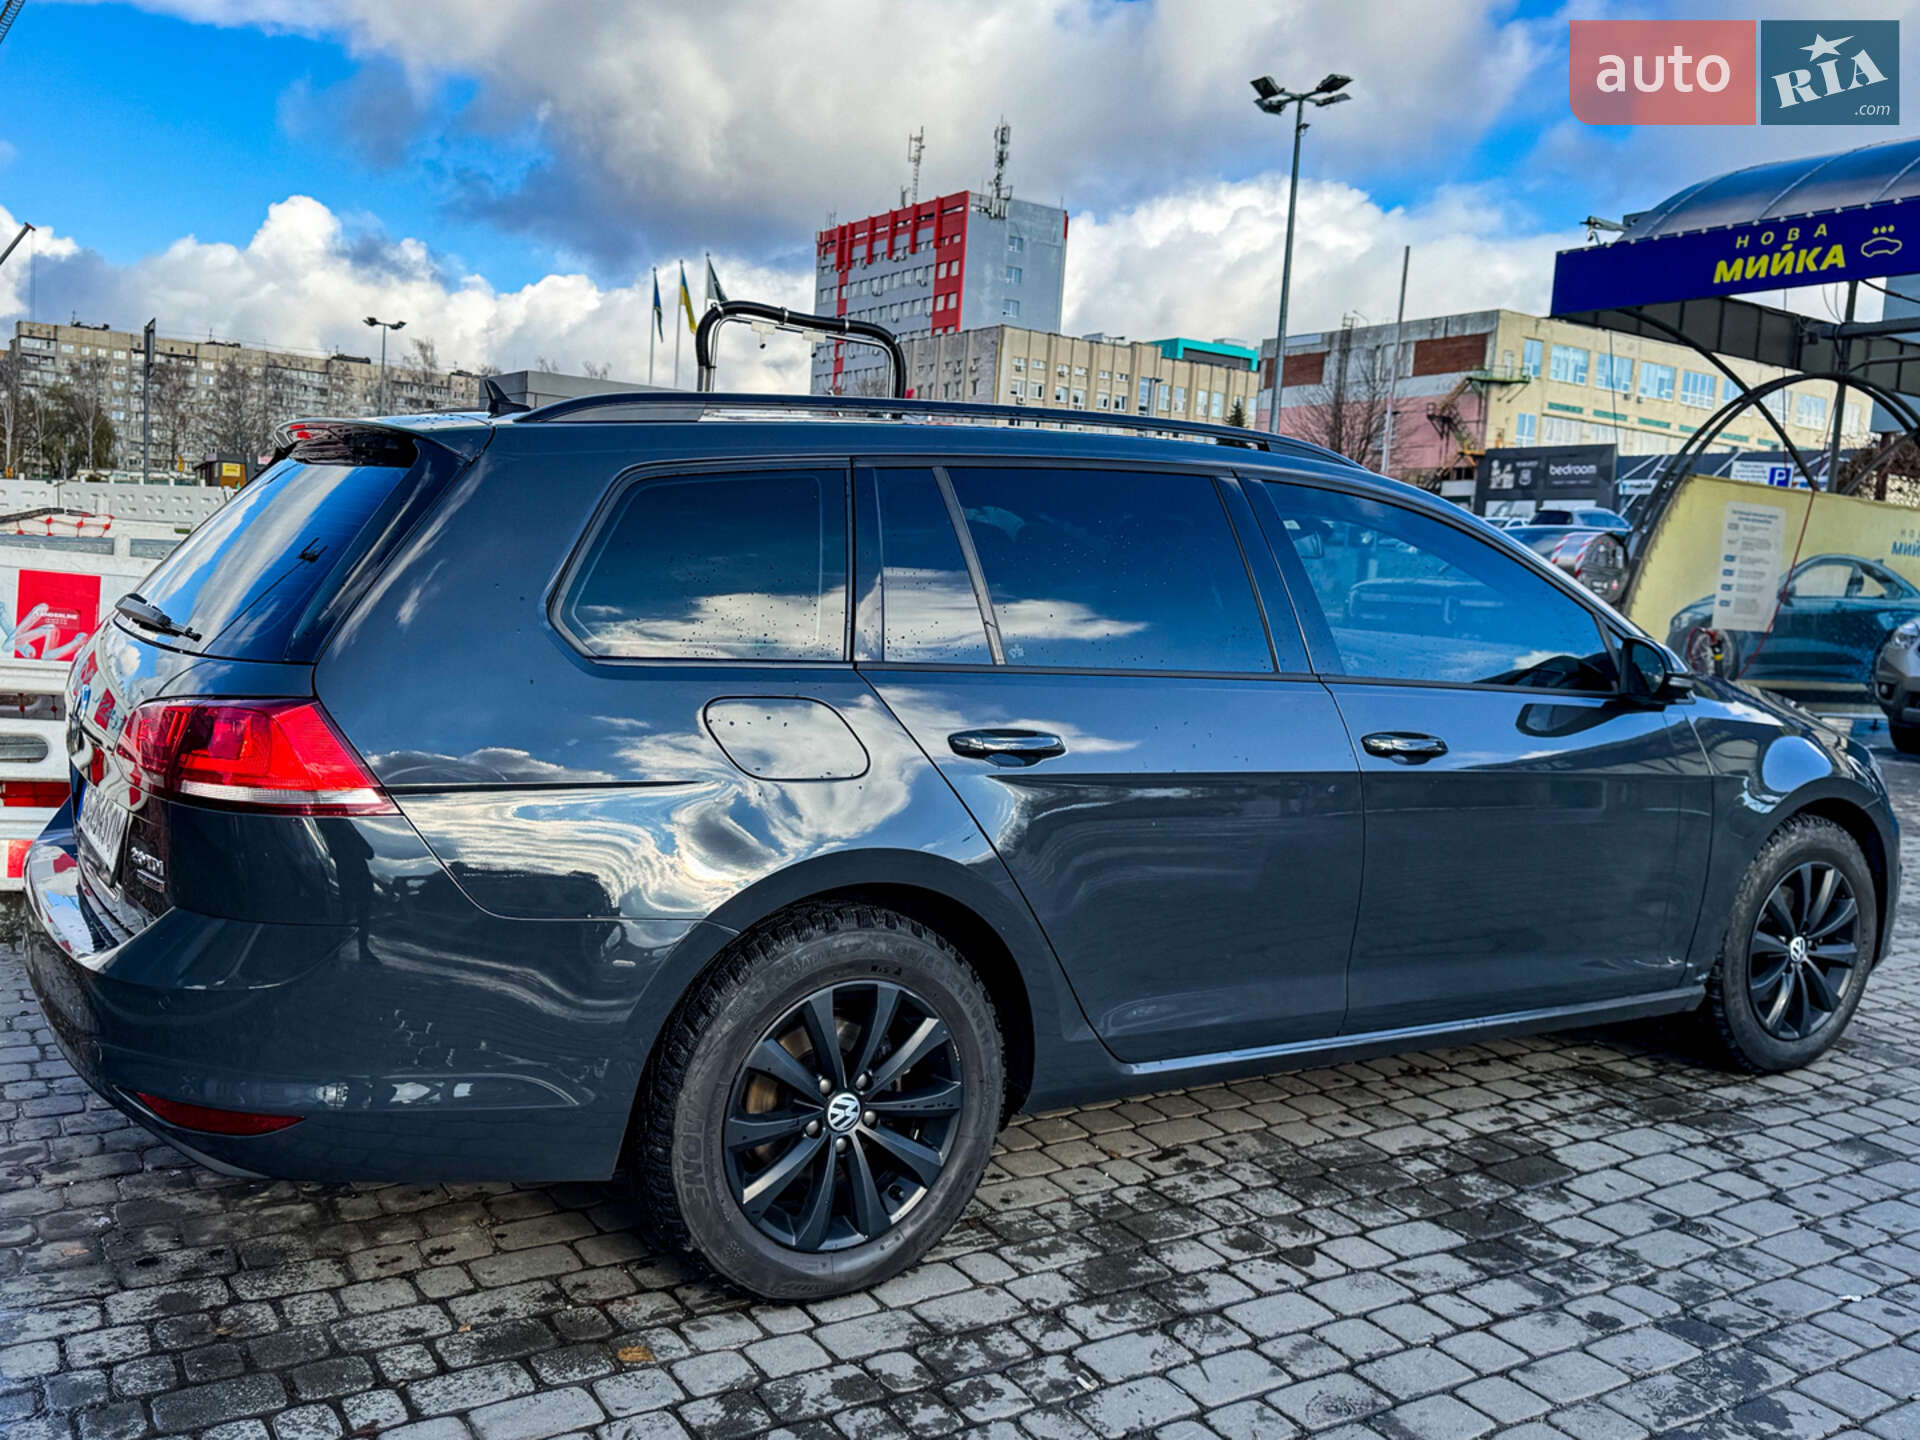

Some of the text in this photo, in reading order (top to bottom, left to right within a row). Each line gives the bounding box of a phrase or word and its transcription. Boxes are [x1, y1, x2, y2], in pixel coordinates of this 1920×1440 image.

[1735, 223, 1828, 249] НОВА
[1712, 243, 1846, 284] МИЙКА
[1548, 463, 1598, 476] bedroom
